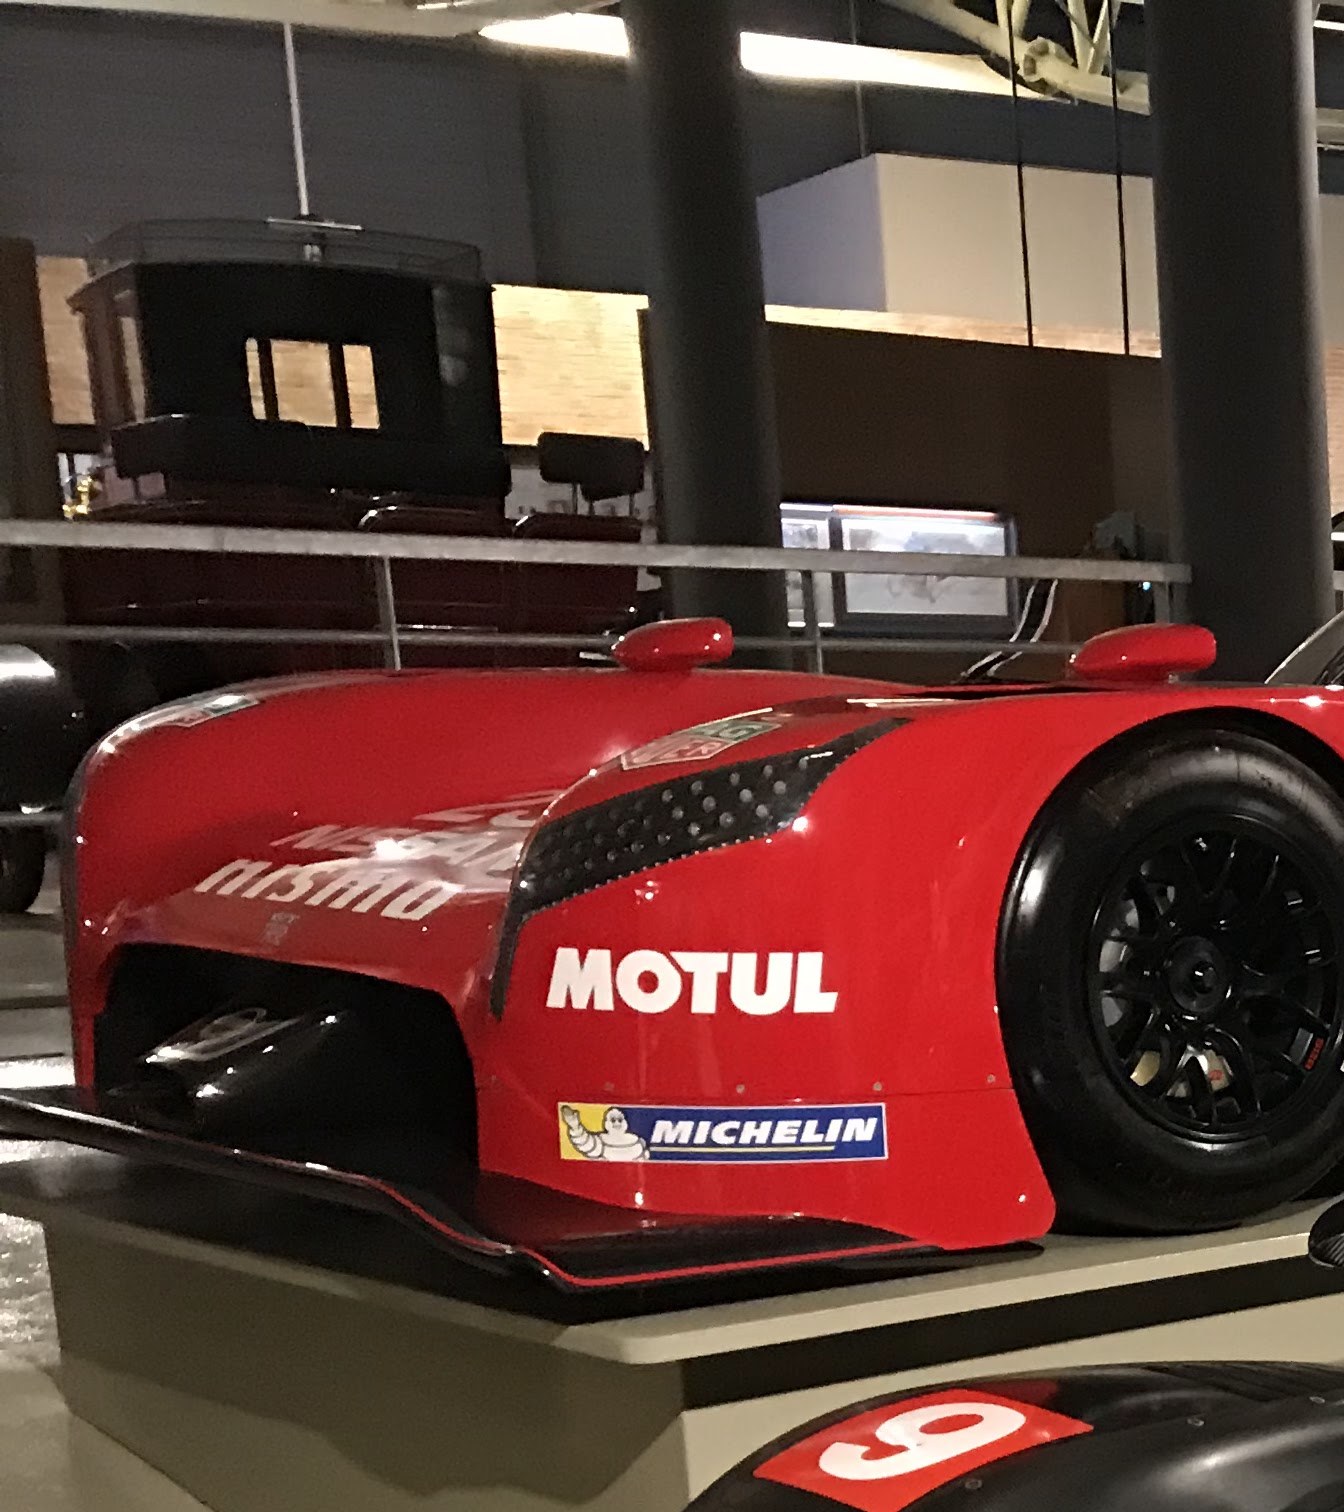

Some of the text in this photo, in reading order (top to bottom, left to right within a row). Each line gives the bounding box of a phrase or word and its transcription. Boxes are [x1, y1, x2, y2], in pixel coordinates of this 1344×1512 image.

[546, 946, 838, 1015] MOTUL
[650, 1117, 877, 1145] MICHELIN
[819, 1402, 1026, 1480] 9
